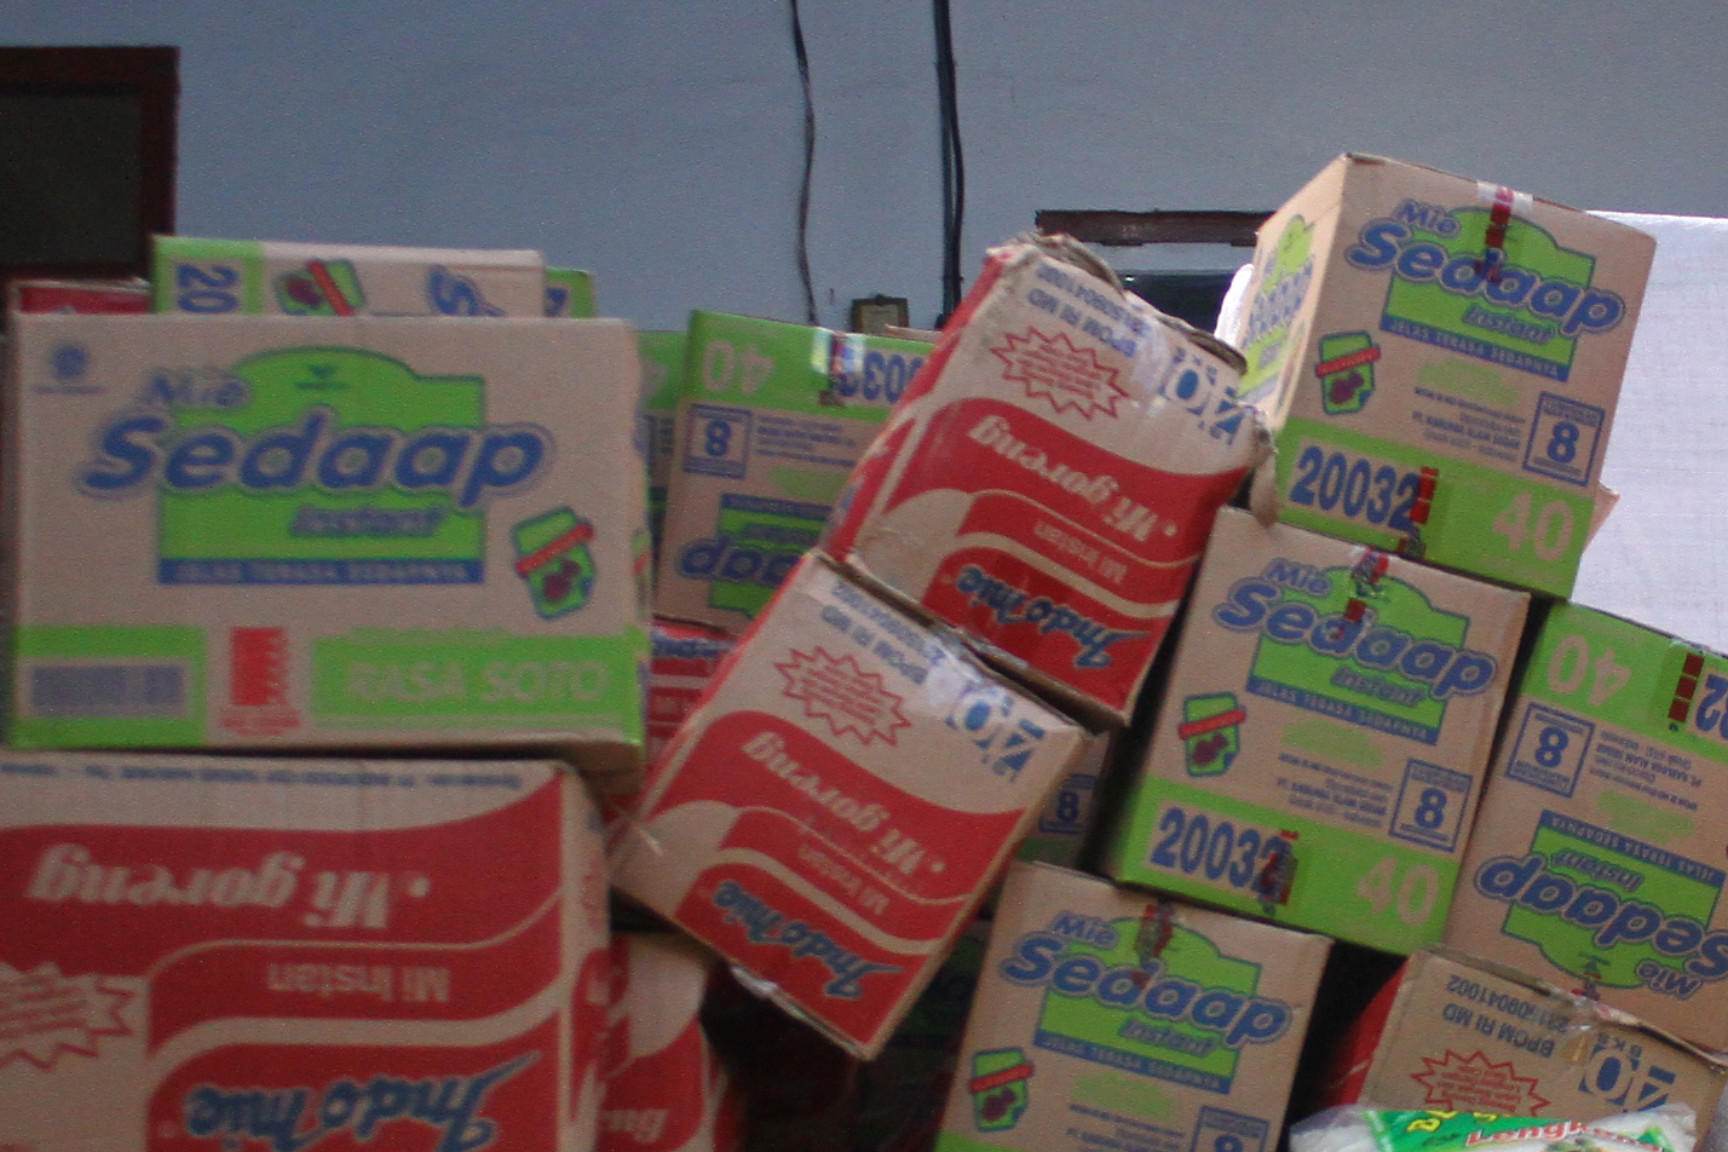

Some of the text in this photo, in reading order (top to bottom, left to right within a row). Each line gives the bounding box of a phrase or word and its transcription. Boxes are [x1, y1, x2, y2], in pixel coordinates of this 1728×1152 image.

[1398, 202, 1459, 236] Mie
[1348, 219, 1626, 336] Sedaap
[705, 341, 775, 395] 40
[80, 406, 550, 510] Sedaap
[704, 420, 731, 458] 8
[1547, 421, 1580, 464] 8
[968, 415, 1161, 542] Mi goreng
[1288, 445, 1421, 532] 20032
[1493, 492, 1574, 561] 40
[1265, 559, 1330, 595] Mie
[1214, 577, 1497, 697] Sedaap
[1550, 635, 1631, 707] 40
[1537, 726, 1570, 769] 8
[742, 730, 926, 874] Mi goreng
[1413, 788, 1447, 829] 8
[27, 842, 392, 928] Mi goreng
[1355, 858, 1440, 924] 40
[1054, 911, 1119, 949] Mie
[1002, 931, 1293, 1048] Sedaap
[1638, 960, 1702, 1000] Mie
[1442, 1003, 1555, 1058] BPOM RI MD
